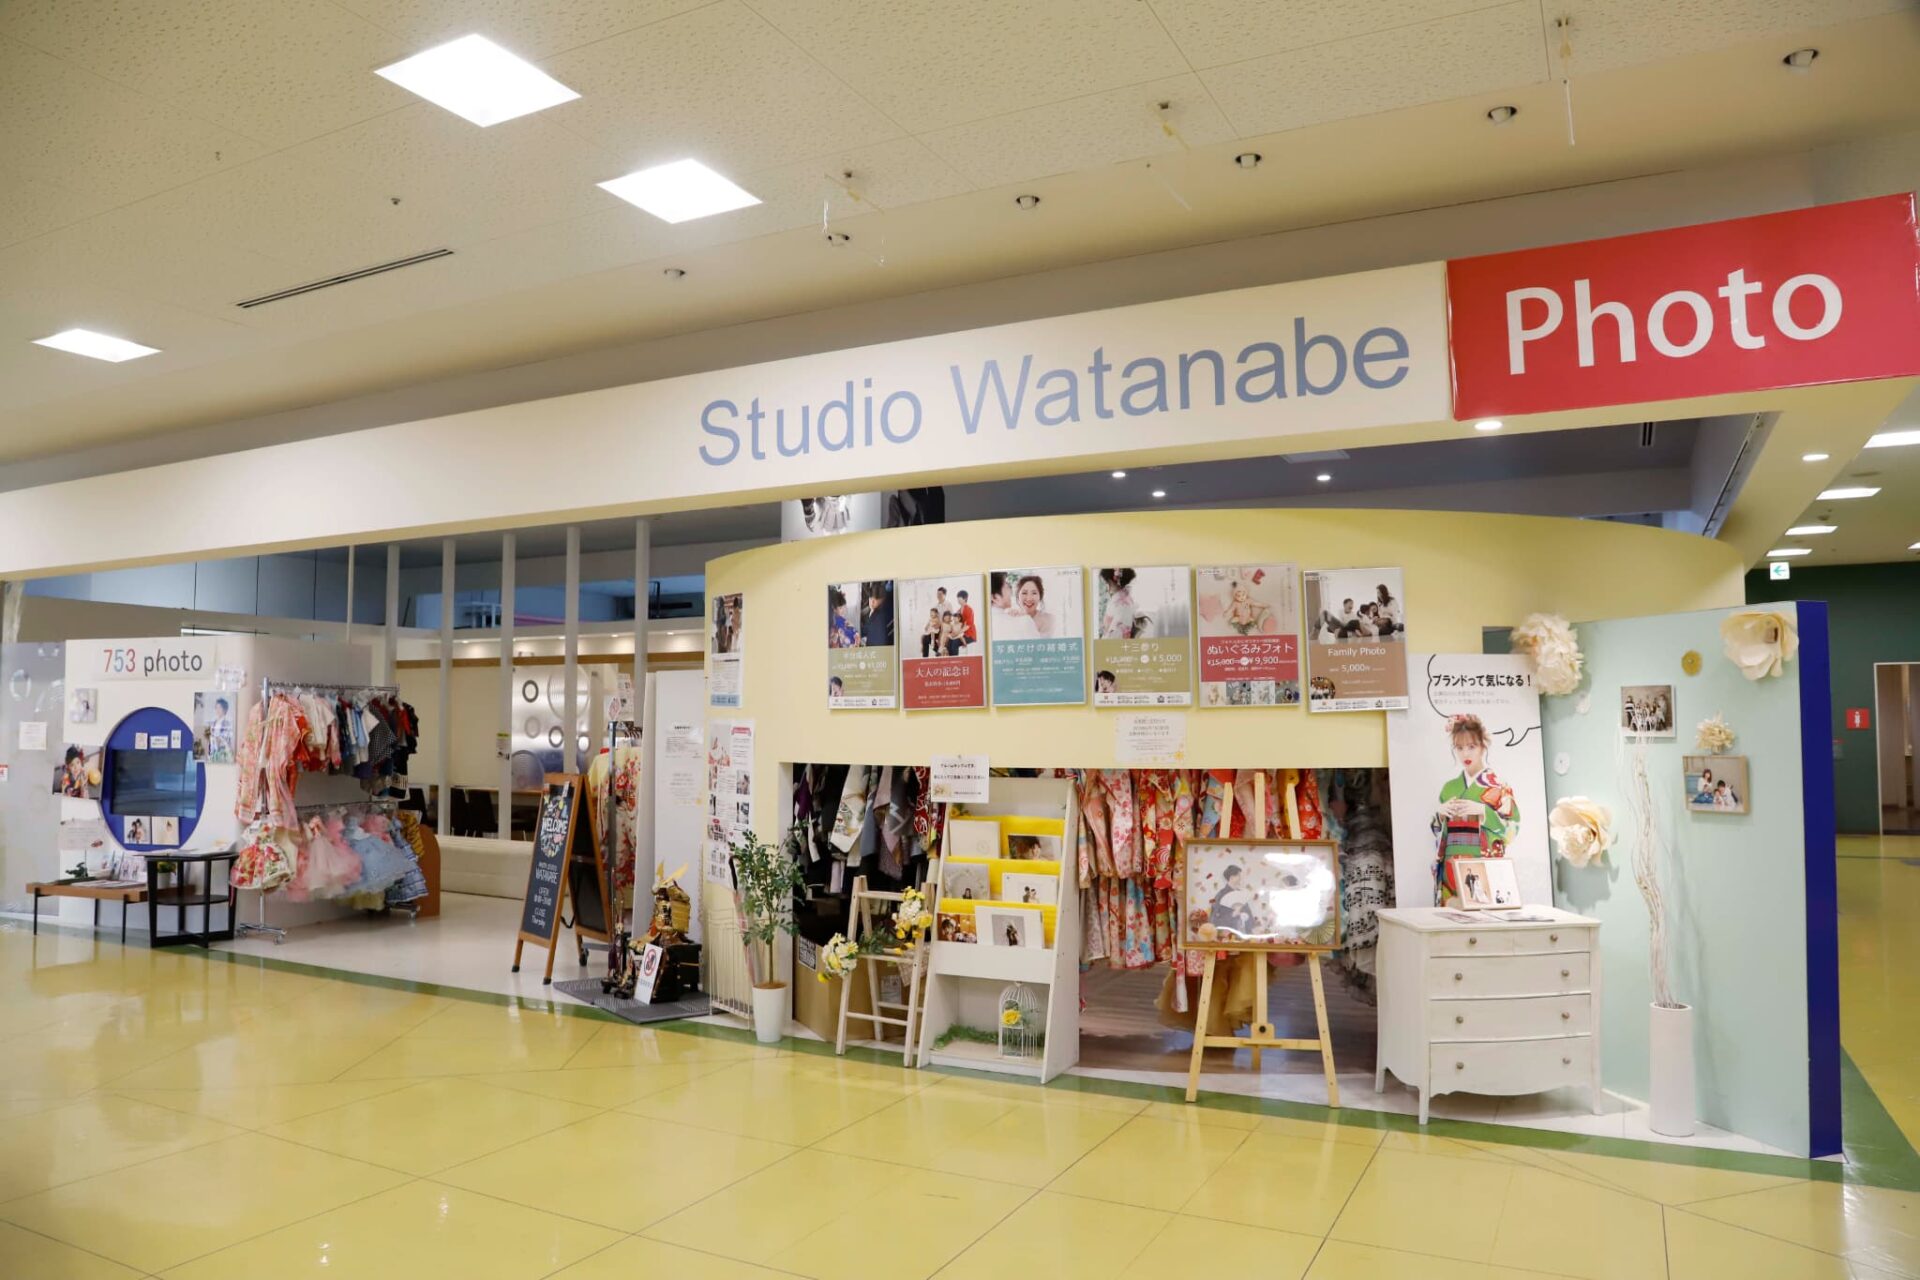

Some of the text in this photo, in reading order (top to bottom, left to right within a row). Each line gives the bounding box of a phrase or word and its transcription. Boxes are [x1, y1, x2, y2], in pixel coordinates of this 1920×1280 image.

[1506, 268, 1843, 375] Photo
[700, 317, 1409, 467] Studio Watanabe
[996, 642, 1078, 654] 写真だけの結婚式
[1206, 642, 1294, 655] ぬいぐるみフォト
[1327, 646, 1386, 657] Family Photo
[103, 648, 203, 677] 753 photo
[915, 666, 970, 678] 大人の記念日
[1432, 673, 1532, 687] ブランドって気になる！
[541, 817, 568, 834] WELCOME
